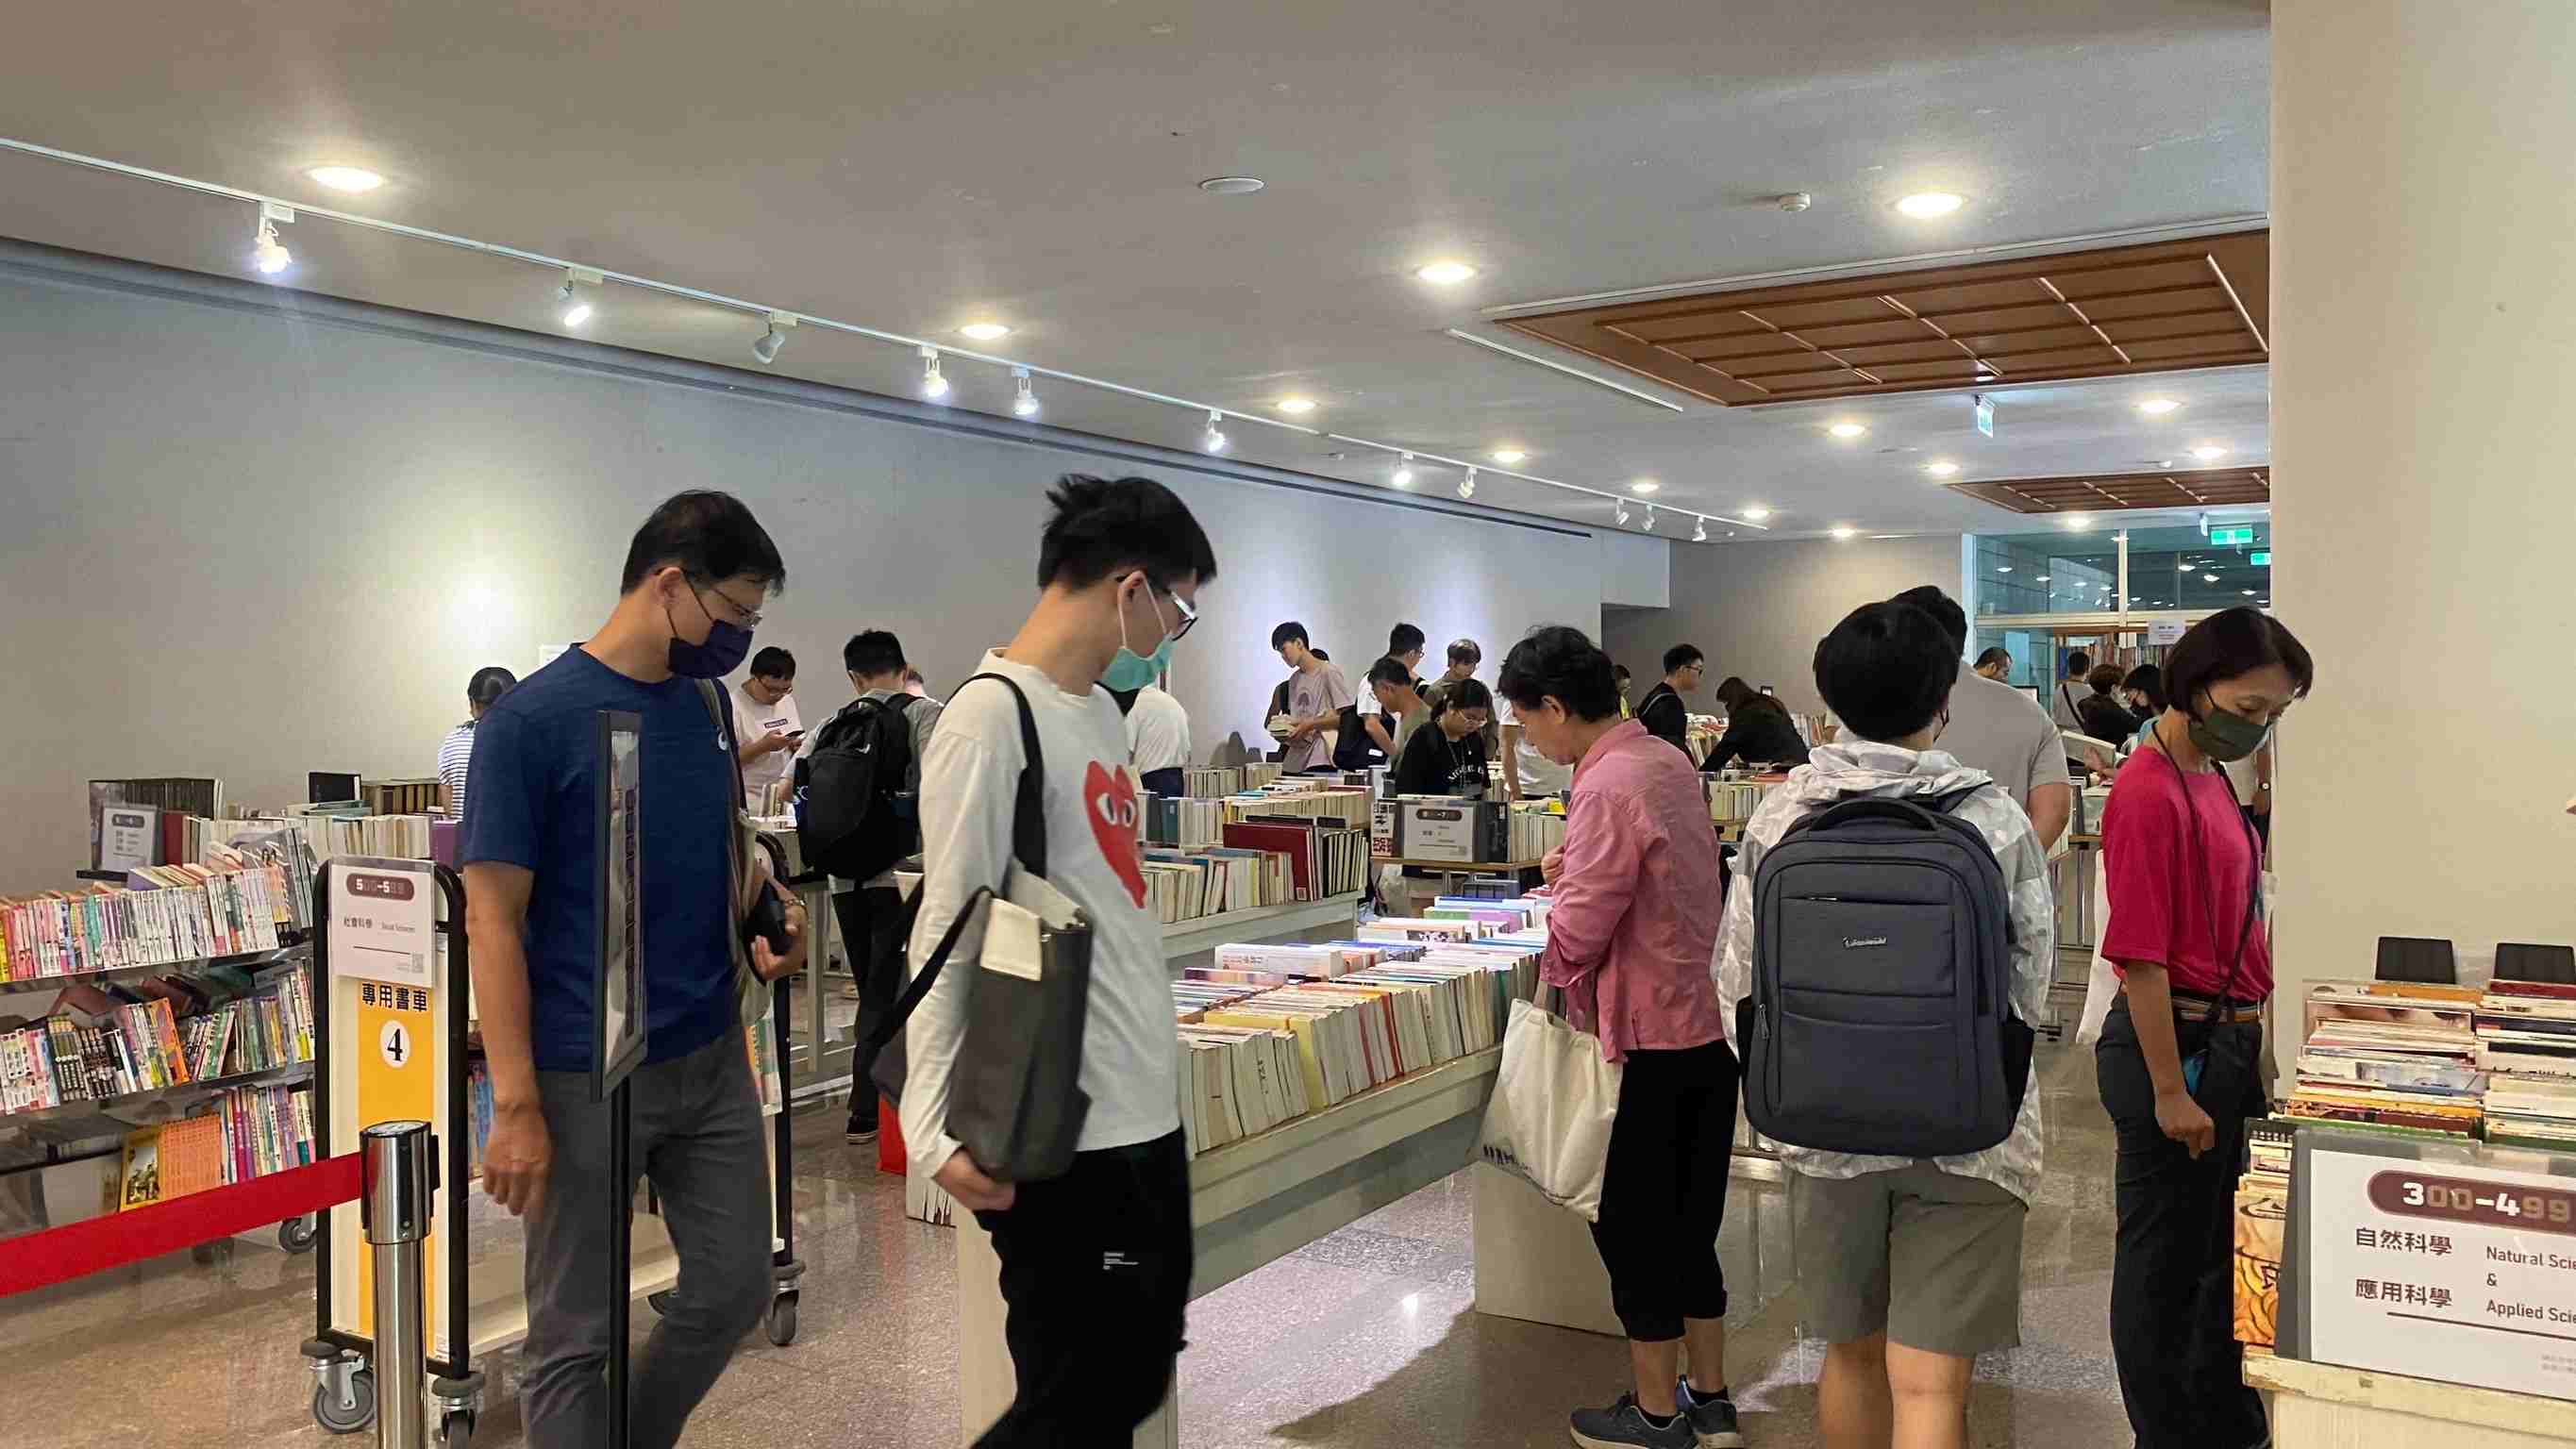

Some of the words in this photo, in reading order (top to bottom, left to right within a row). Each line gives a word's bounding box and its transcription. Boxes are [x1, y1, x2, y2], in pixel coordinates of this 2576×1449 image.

[362, 983, 427, 1011] 專用書車
[387, 1028, 403, 1062] 4
[2402, 1182, 2570, 1223] 300-499
[2355, 1227, 2452, 1256] 自然科學
[2486, 1245, 2545, 1267] Natural
[2355, 1279, 2452, 1307] 應用科學
[2486, 1273, 2498, 1288] &
[2486, 1299, 2544, 1320] Applied
